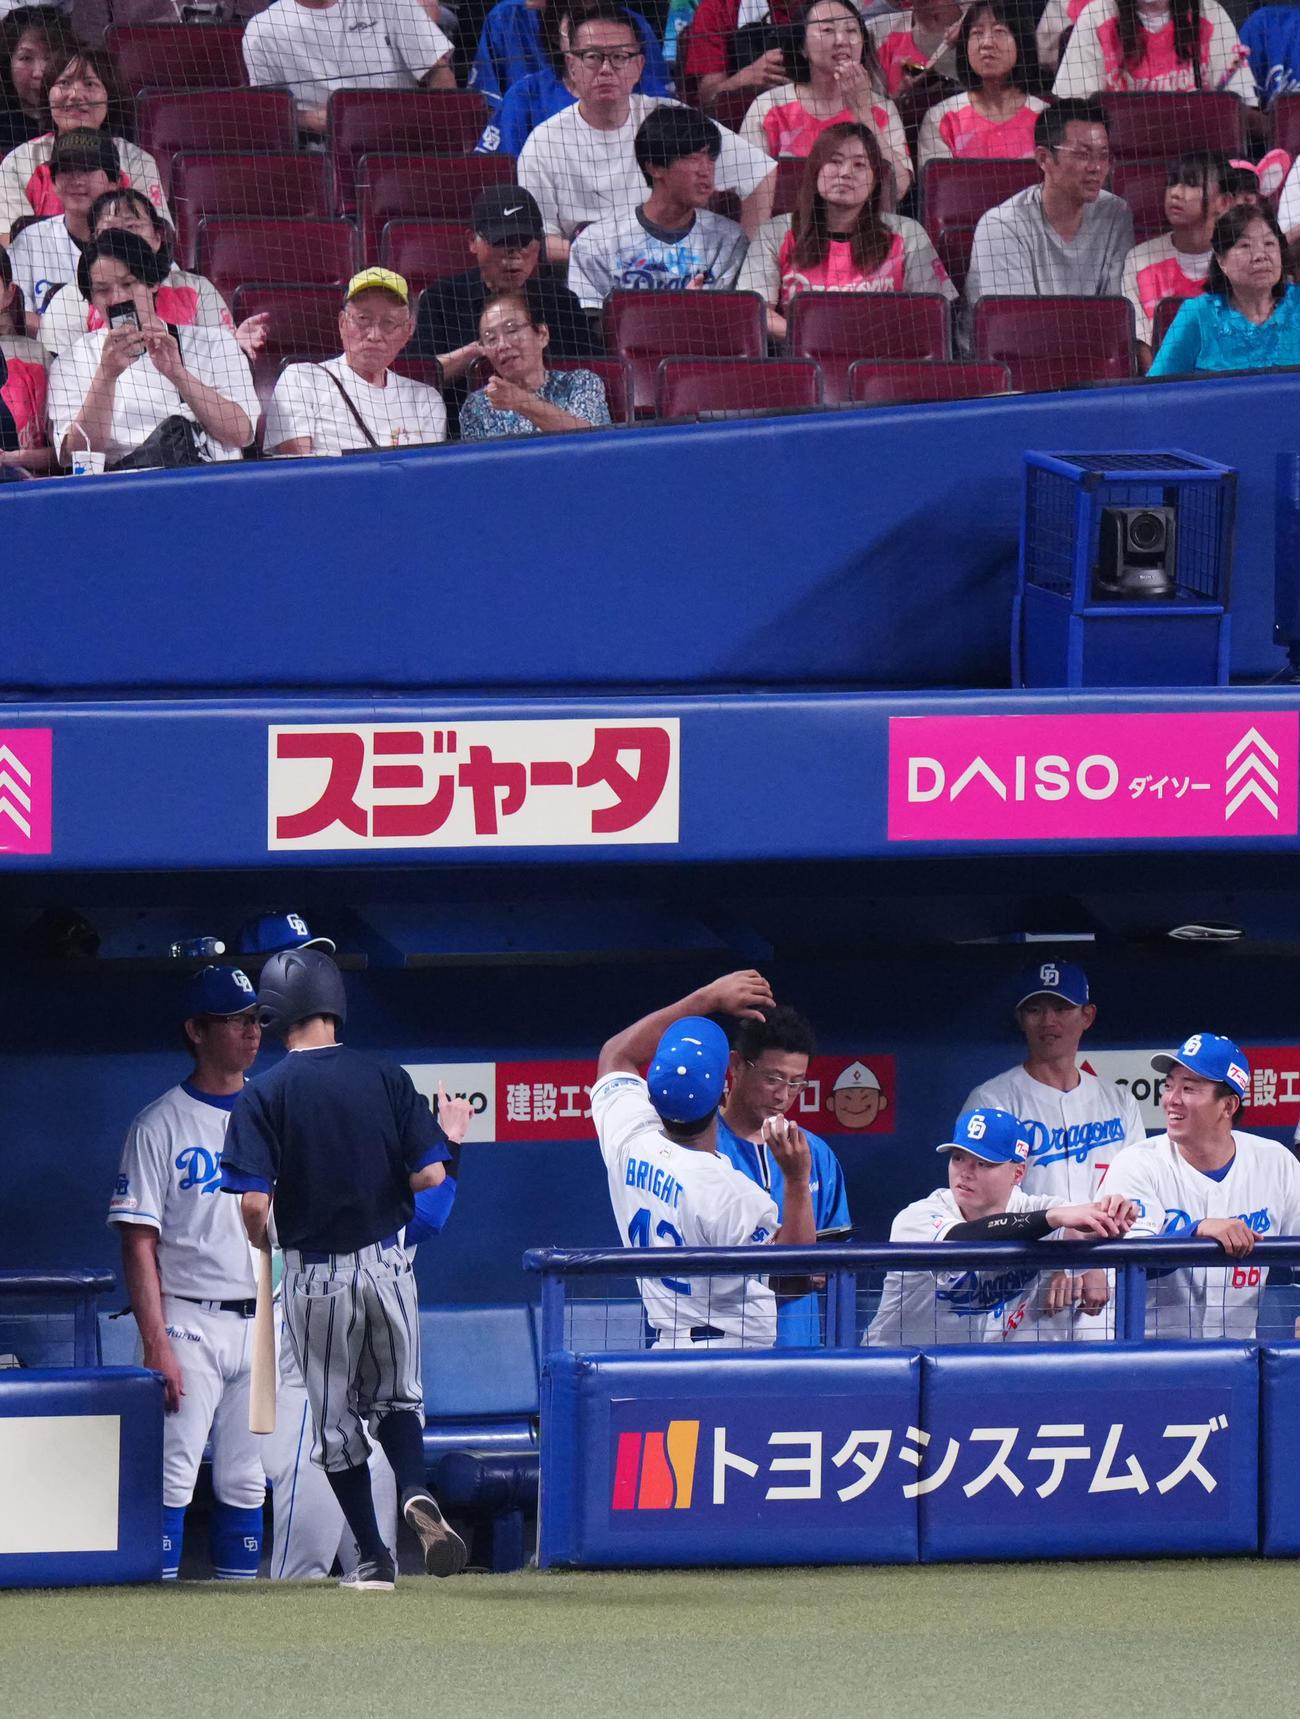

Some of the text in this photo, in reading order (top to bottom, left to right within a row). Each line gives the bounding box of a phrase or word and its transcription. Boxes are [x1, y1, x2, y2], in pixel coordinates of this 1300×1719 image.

[276, 727, 671, 839] スジャータ
[908, 754, 1119, 802] DAISO
[1127, 775, 1211, 799] ダイソー
[1021, 1117, 1126, 1168] Dragons
[625, 1157, 684, 1209] BRIGHT
[987, 1217, 1008, 1229] 2XU
[1231, 1266, 1261, 1289] 66
[712, 1414, 1229, 1504] トヨタシステムズ
